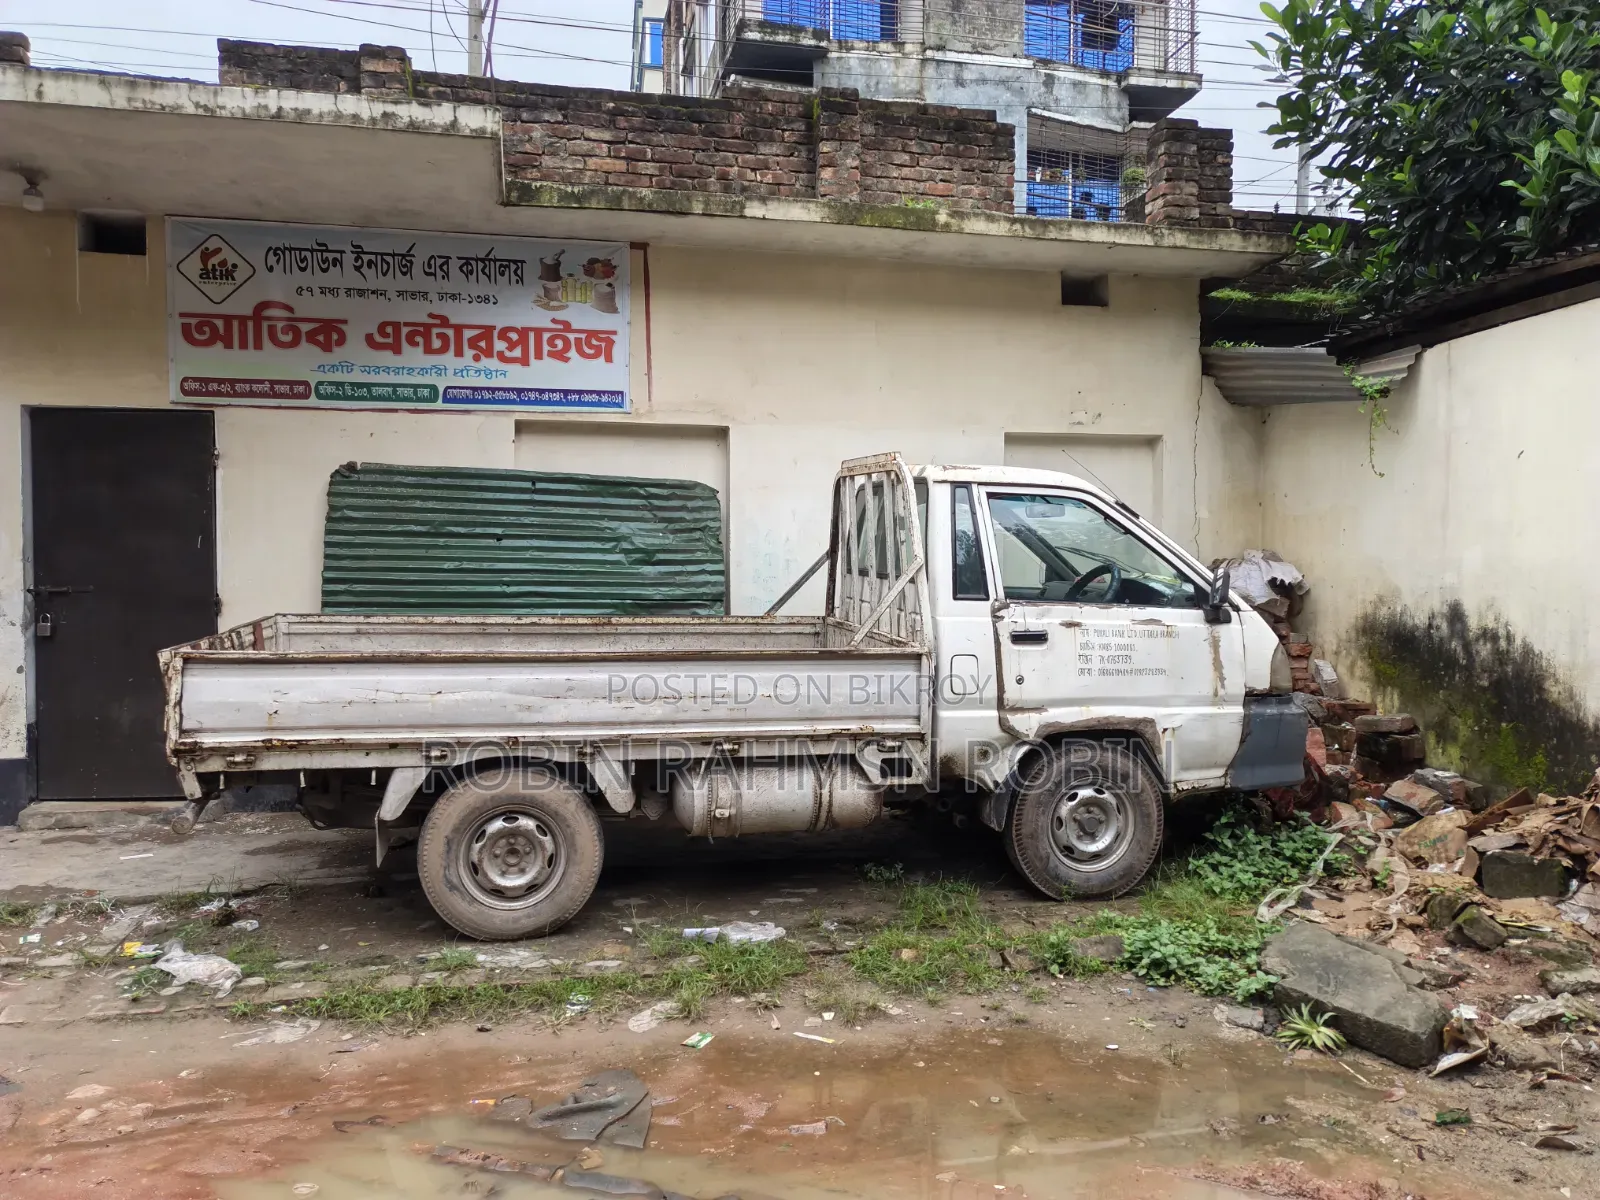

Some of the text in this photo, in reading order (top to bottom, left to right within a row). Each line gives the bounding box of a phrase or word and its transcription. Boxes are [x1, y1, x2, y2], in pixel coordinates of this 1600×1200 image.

[199, 264, 238, 281] atik
[264, 238, 527, 287] গোডাউন ইনচার্জ এর কার্যালয়
[296, 285, 499, 305] ৫৭ মধ্য রাজাশন, সাভার, ঢাকা-১৩৪১
[179, 300, 618, 367] আতিক এন্টারপ্রাইজ
[310, 361, 509, 380] একটি সরবরাহকারী প্রতিষ্ঠান
